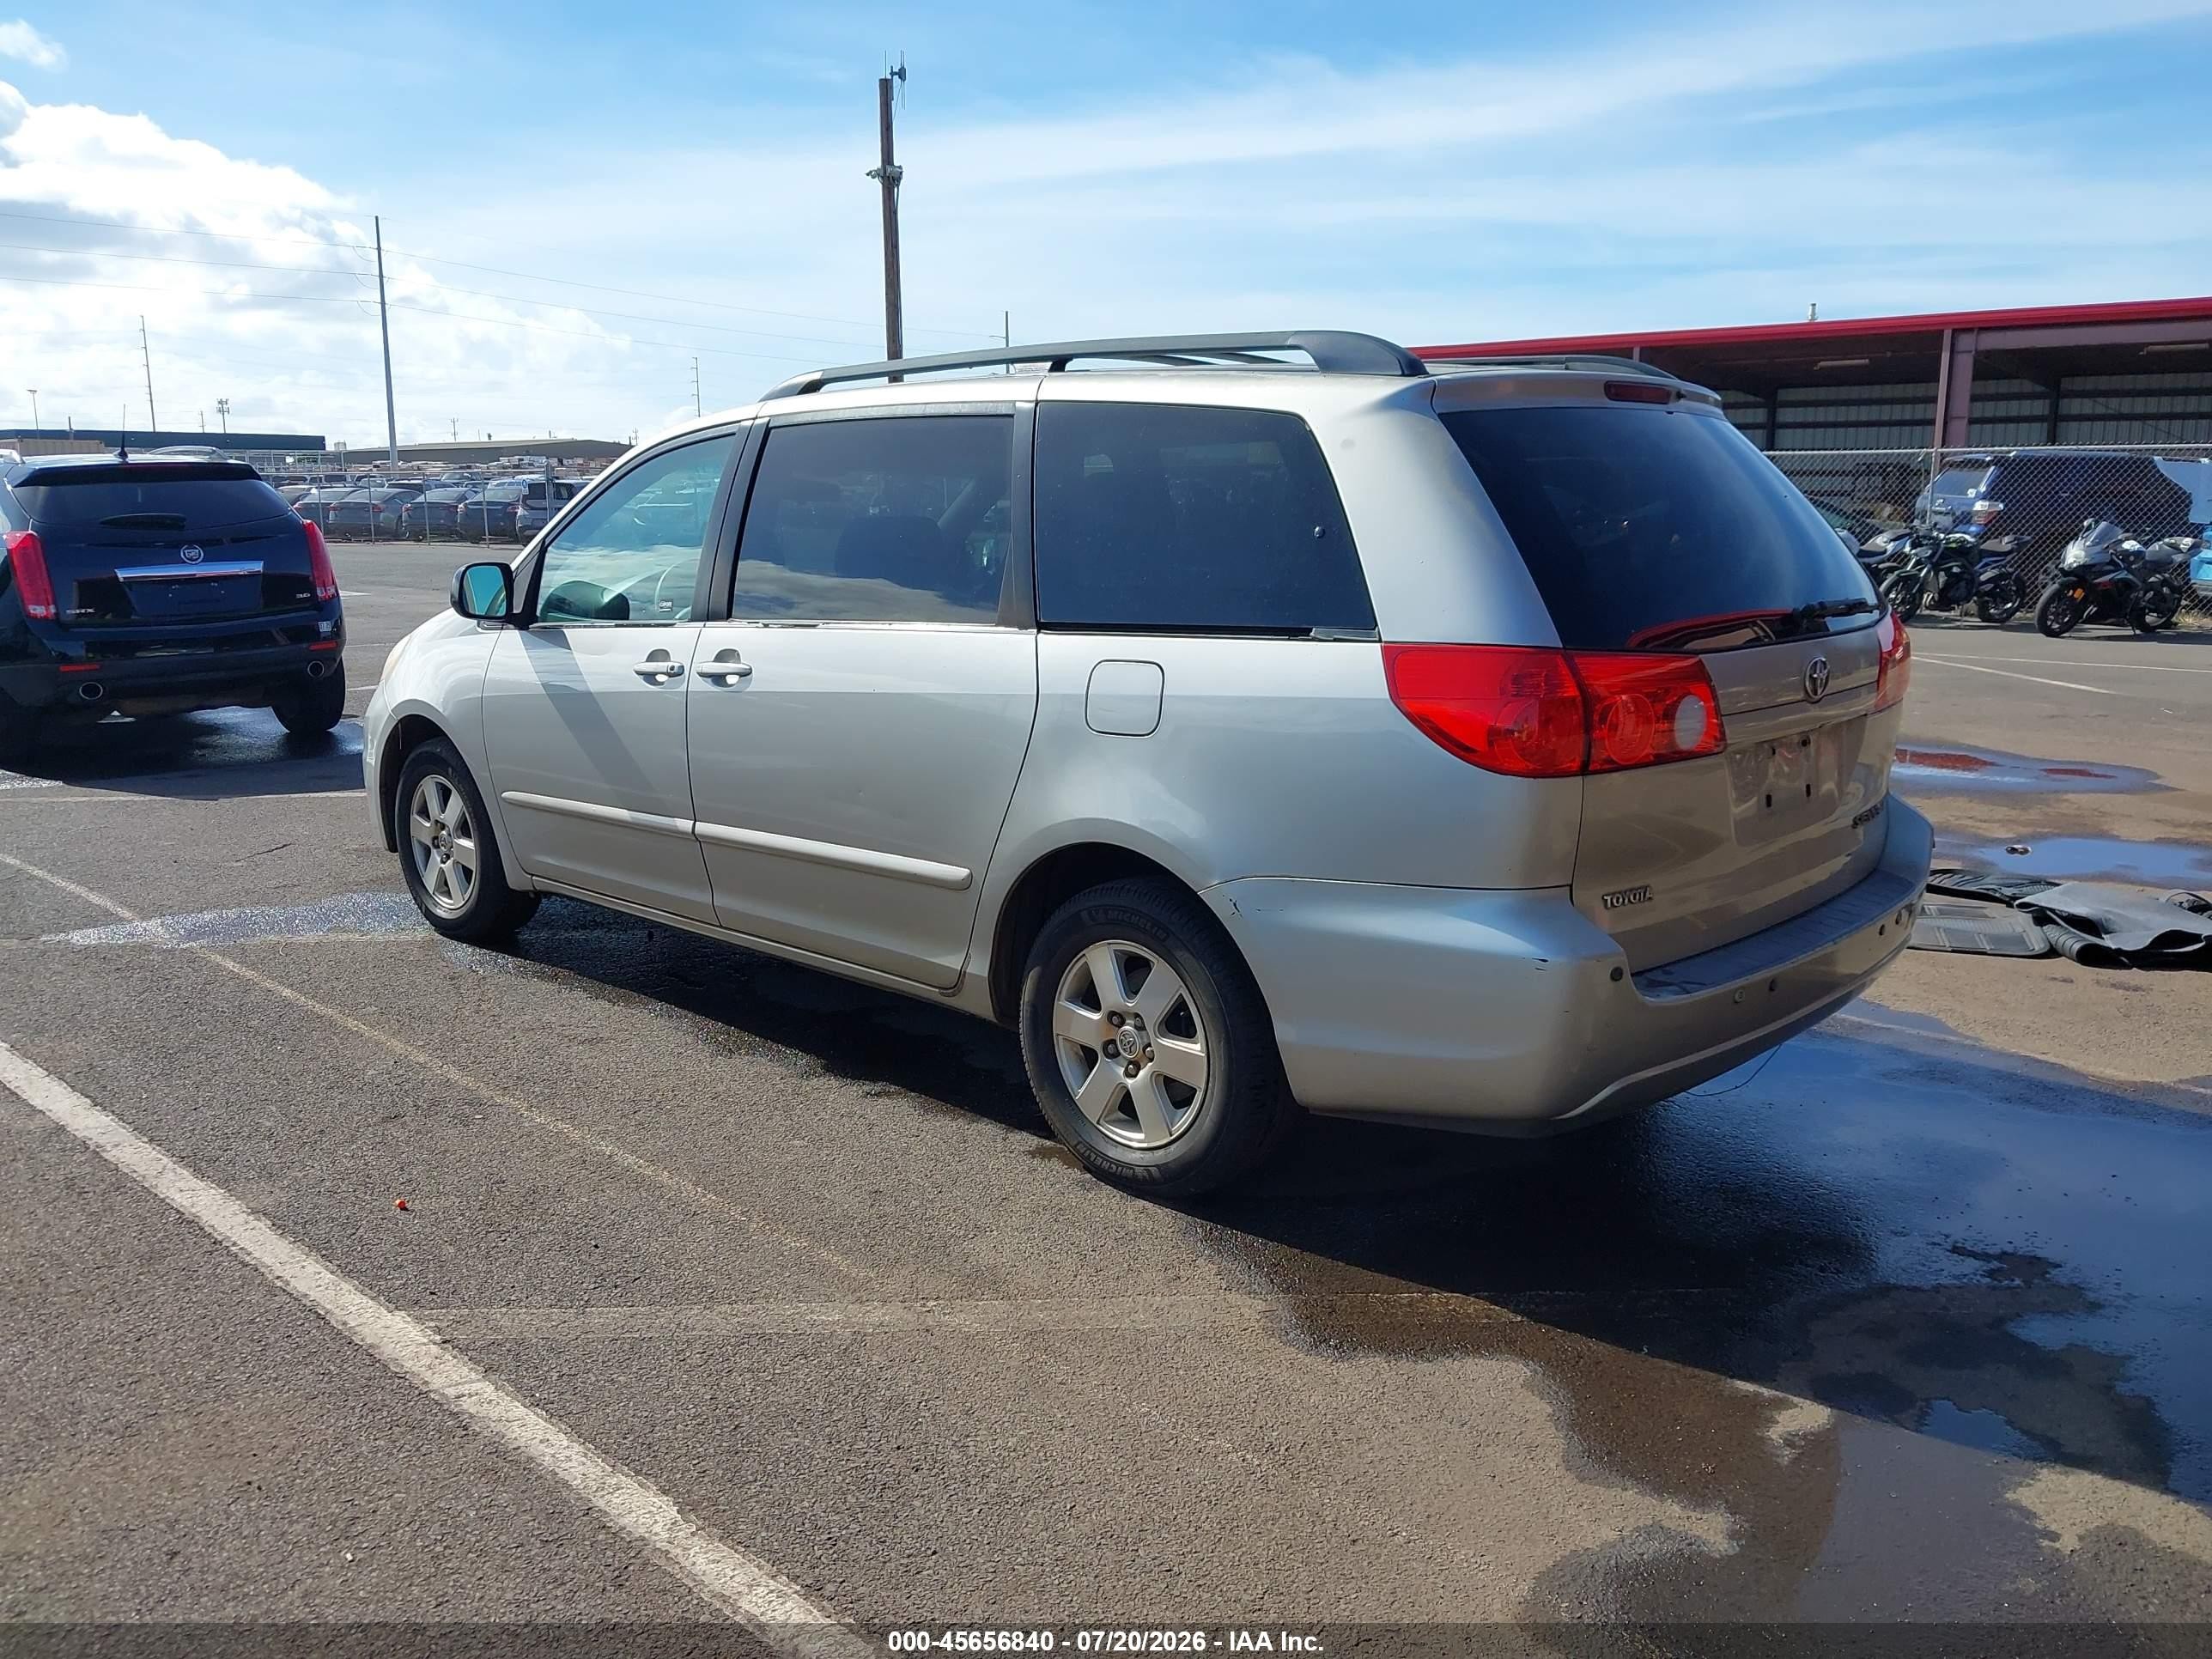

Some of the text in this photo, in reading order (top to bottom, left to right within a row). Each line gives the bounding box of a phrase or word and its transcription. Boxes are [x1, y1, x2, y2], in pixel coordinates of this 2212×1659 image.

[1602, 885, 1653, 908] TOYOTA
[1107, 909, 1169, 942] MICHELIN
[1073, 1141, 1136, 1177] MICHELIN
